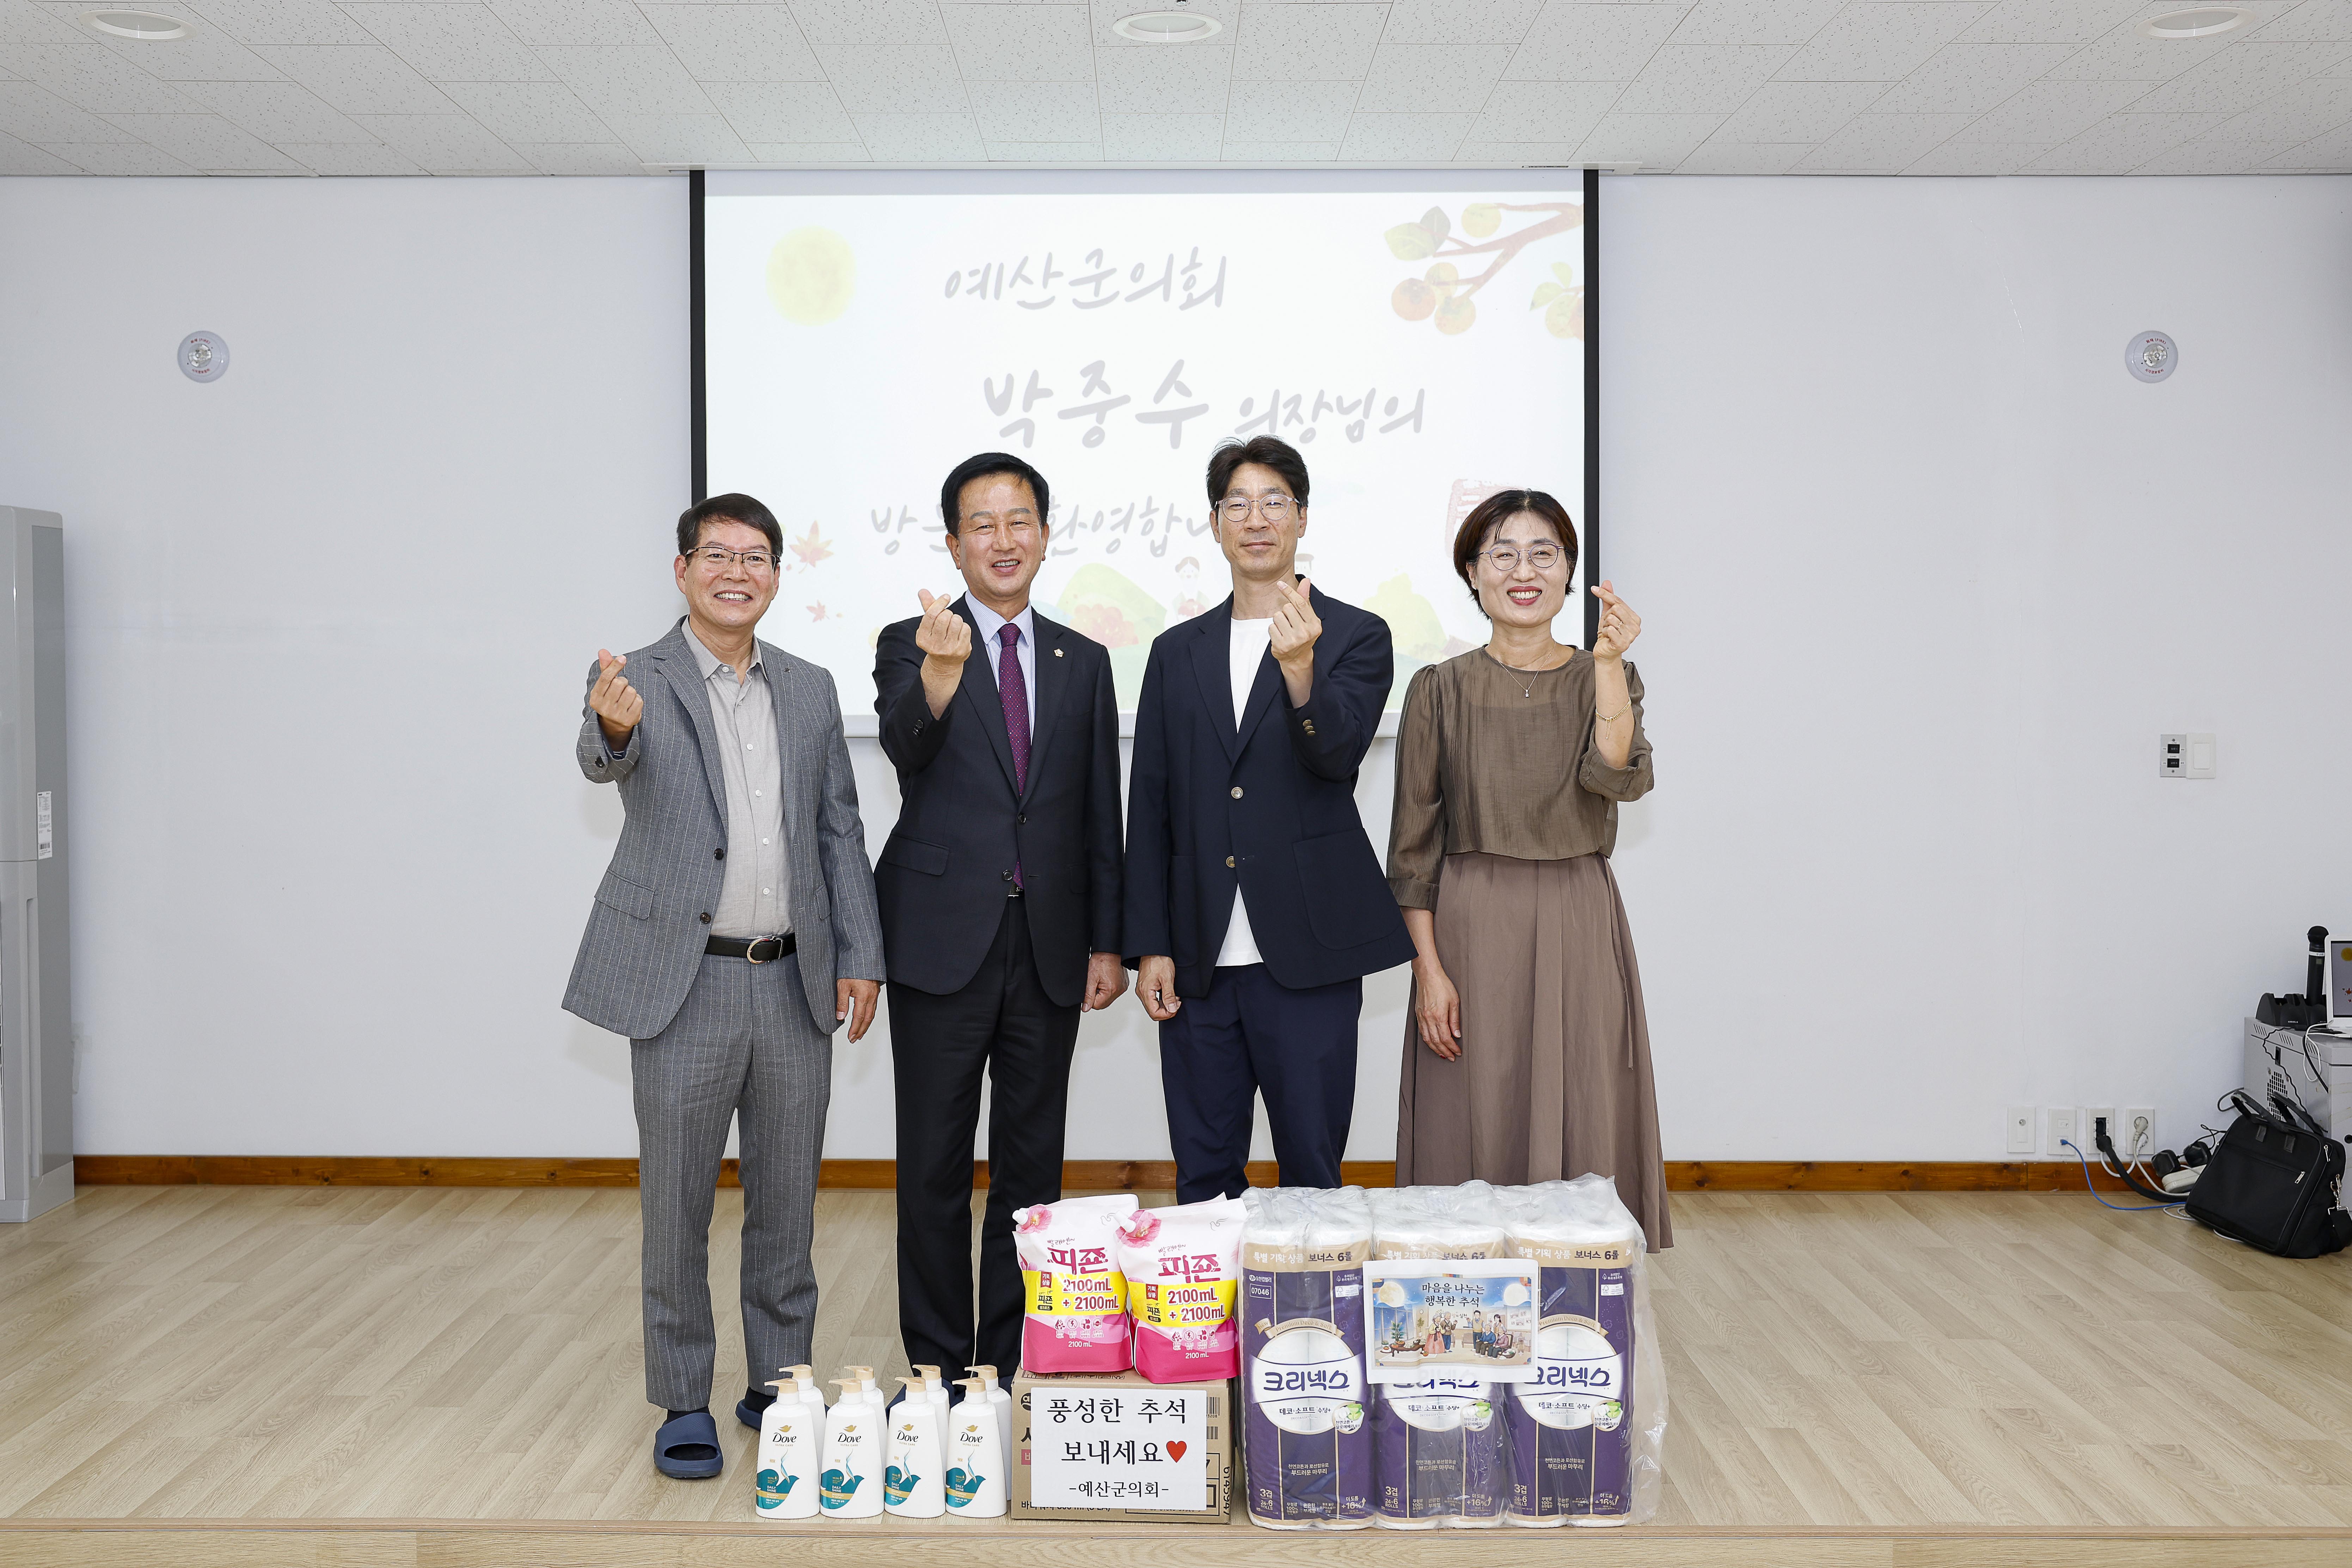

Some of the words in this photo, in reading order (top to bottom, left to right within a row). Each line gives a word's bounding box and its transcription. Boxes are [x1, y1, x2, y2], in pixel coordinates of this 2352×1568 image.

[945, 246, 1227, 311] 예산군의회
[1234, 387, 1425, 444] 의장님의
[1254, 1252, 1267, 1263] 특별
[1270, 1253, 1286, 1263] 기획
[1287, 1253, 1304, 1264] 상품
[1308, 1253, 1335, 1262] 보너스
[1337, 1251, 1352, 1262] 6롤
[1518, 1247, 1533, 1258] 특별
[1536, 1248, 1551, 1258] 기획
[1554, 1249, 1571, 1259] 상품
[1574, 1250, 1601, 1260] 보너스
[1604, 1250, 1619, 1260] 6롤
[1047, 1247, 1108, 1275] 피죤
[1158, 1254, 1221, 1283] 피죤
[1251, 1287, 1269, 1296] 07046
[1422, 1282, 1452, 1294] 마음을
[1454, 1284, 1485, 1295] 나누는
[1038, 1295, 1053, 1304] 피죤
[1425, 1296, 1456, 1307] 행복한
[1459, 1297, 1480, 1307] 추석
[1147, 1306, 1160, 1316] 피죤
[1276, 1321, 1300, 1332] Premium
[1539, 1317, 1564, 1326] Premium
[1584, 1319, 1595, 1327] Soft
[1263, 1370, 1350, 1391] 크리넥스
[1047, 1398, 1123, 1423] 풍성한
[1137, 1398, 1186, 1424] 추석
[772, 1432, 797, 1443] Dove
[838, 1432, 861, 1443] Dove
[897, 1430, 919, 1442] Dove
[960, 1432, 983, 1443] Dove
[1061, 1439, 1163, 1465] 보내세요
[1069, 1481, 1169, 1498] -예산군의회-
[1260, 1488, 1272, 1499] 3겹
[1385, 1486, 1398, 1497] 3겹
[1514, 1484, 1527, 1494] 3겹
